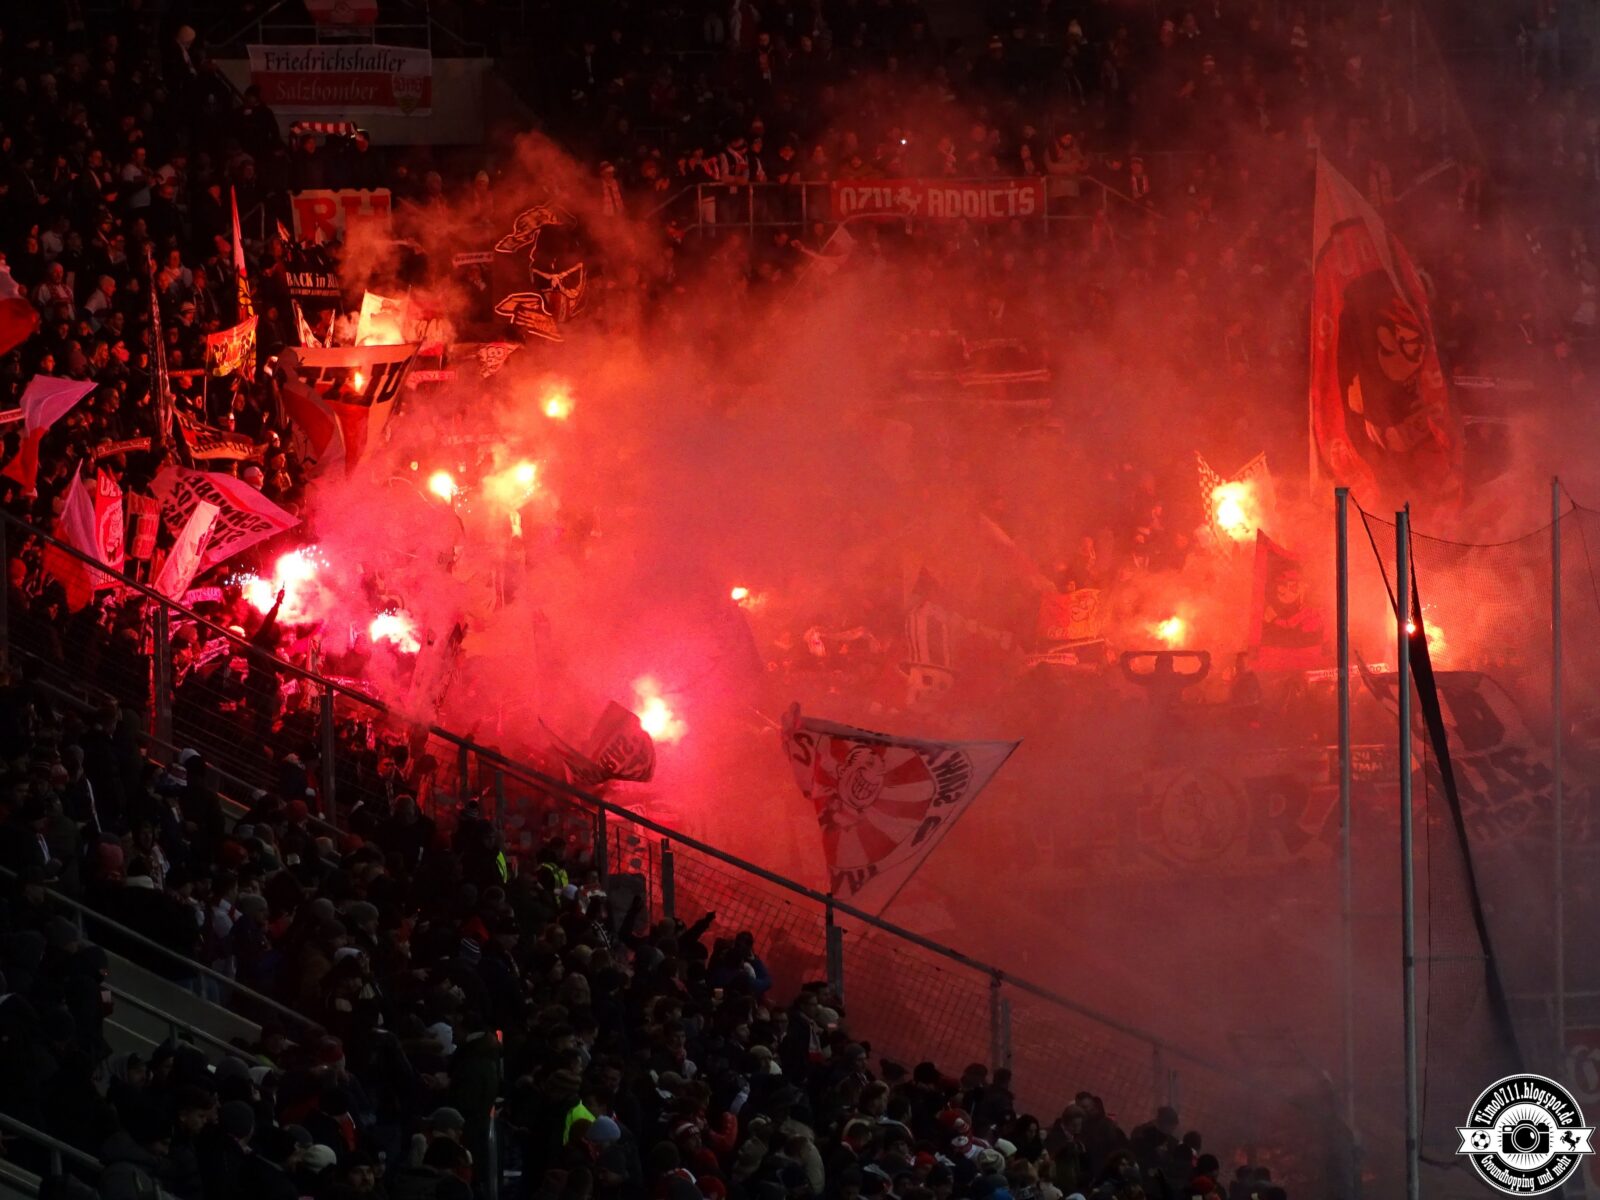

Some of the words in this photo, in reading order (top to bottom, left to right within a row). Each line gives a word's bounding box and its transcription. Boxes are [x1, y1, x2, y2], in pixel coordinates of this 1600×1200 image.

[264, 48, 406, 72] Friedrichshaller
[276, 78, 379, 101] Salzbomber
[928, 186, 1036, 217] ADDICTS
[286, 272, 314, 288] BACK
[316, 273, 326, 288] in
